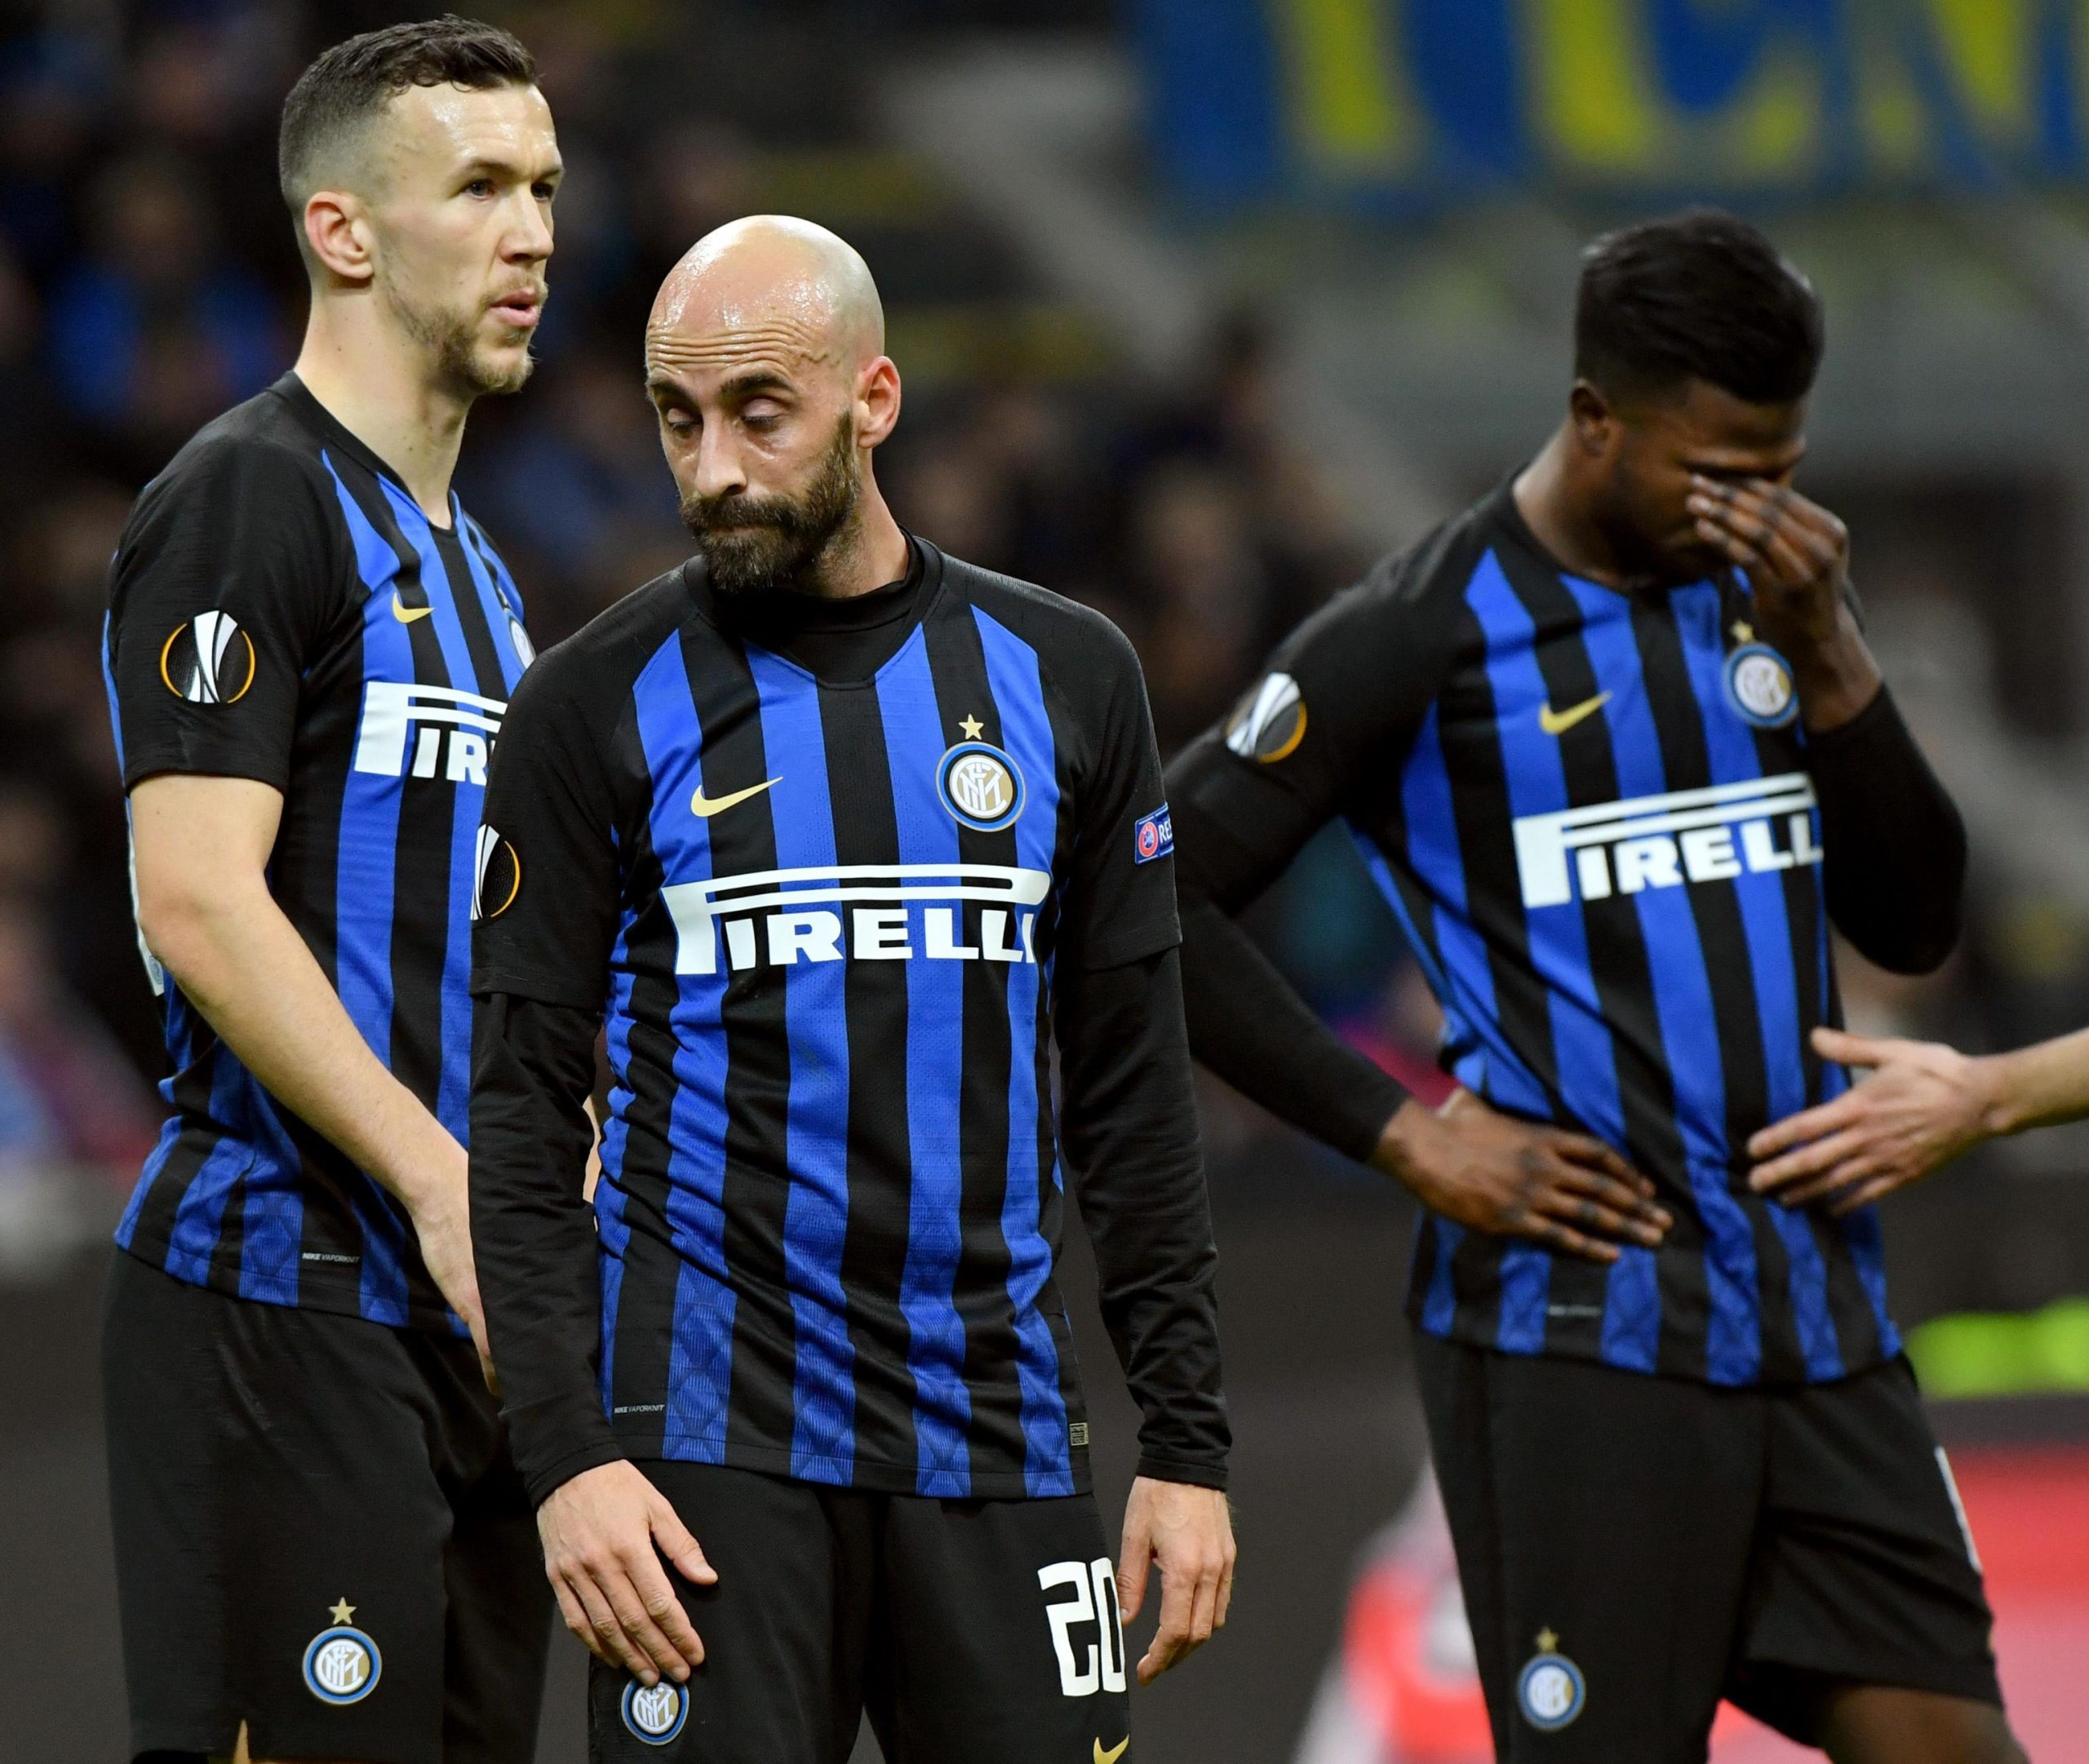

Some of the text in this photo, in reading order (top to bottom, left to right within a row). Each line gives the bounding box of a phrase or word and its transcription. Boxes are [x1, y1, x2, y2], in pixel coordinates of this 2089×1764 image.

[1512, 771, 1825, 909] PIRELL
[660, 863, 1051, 975] PIRELLI
[1037, 1557, 1127, 1697] 20
